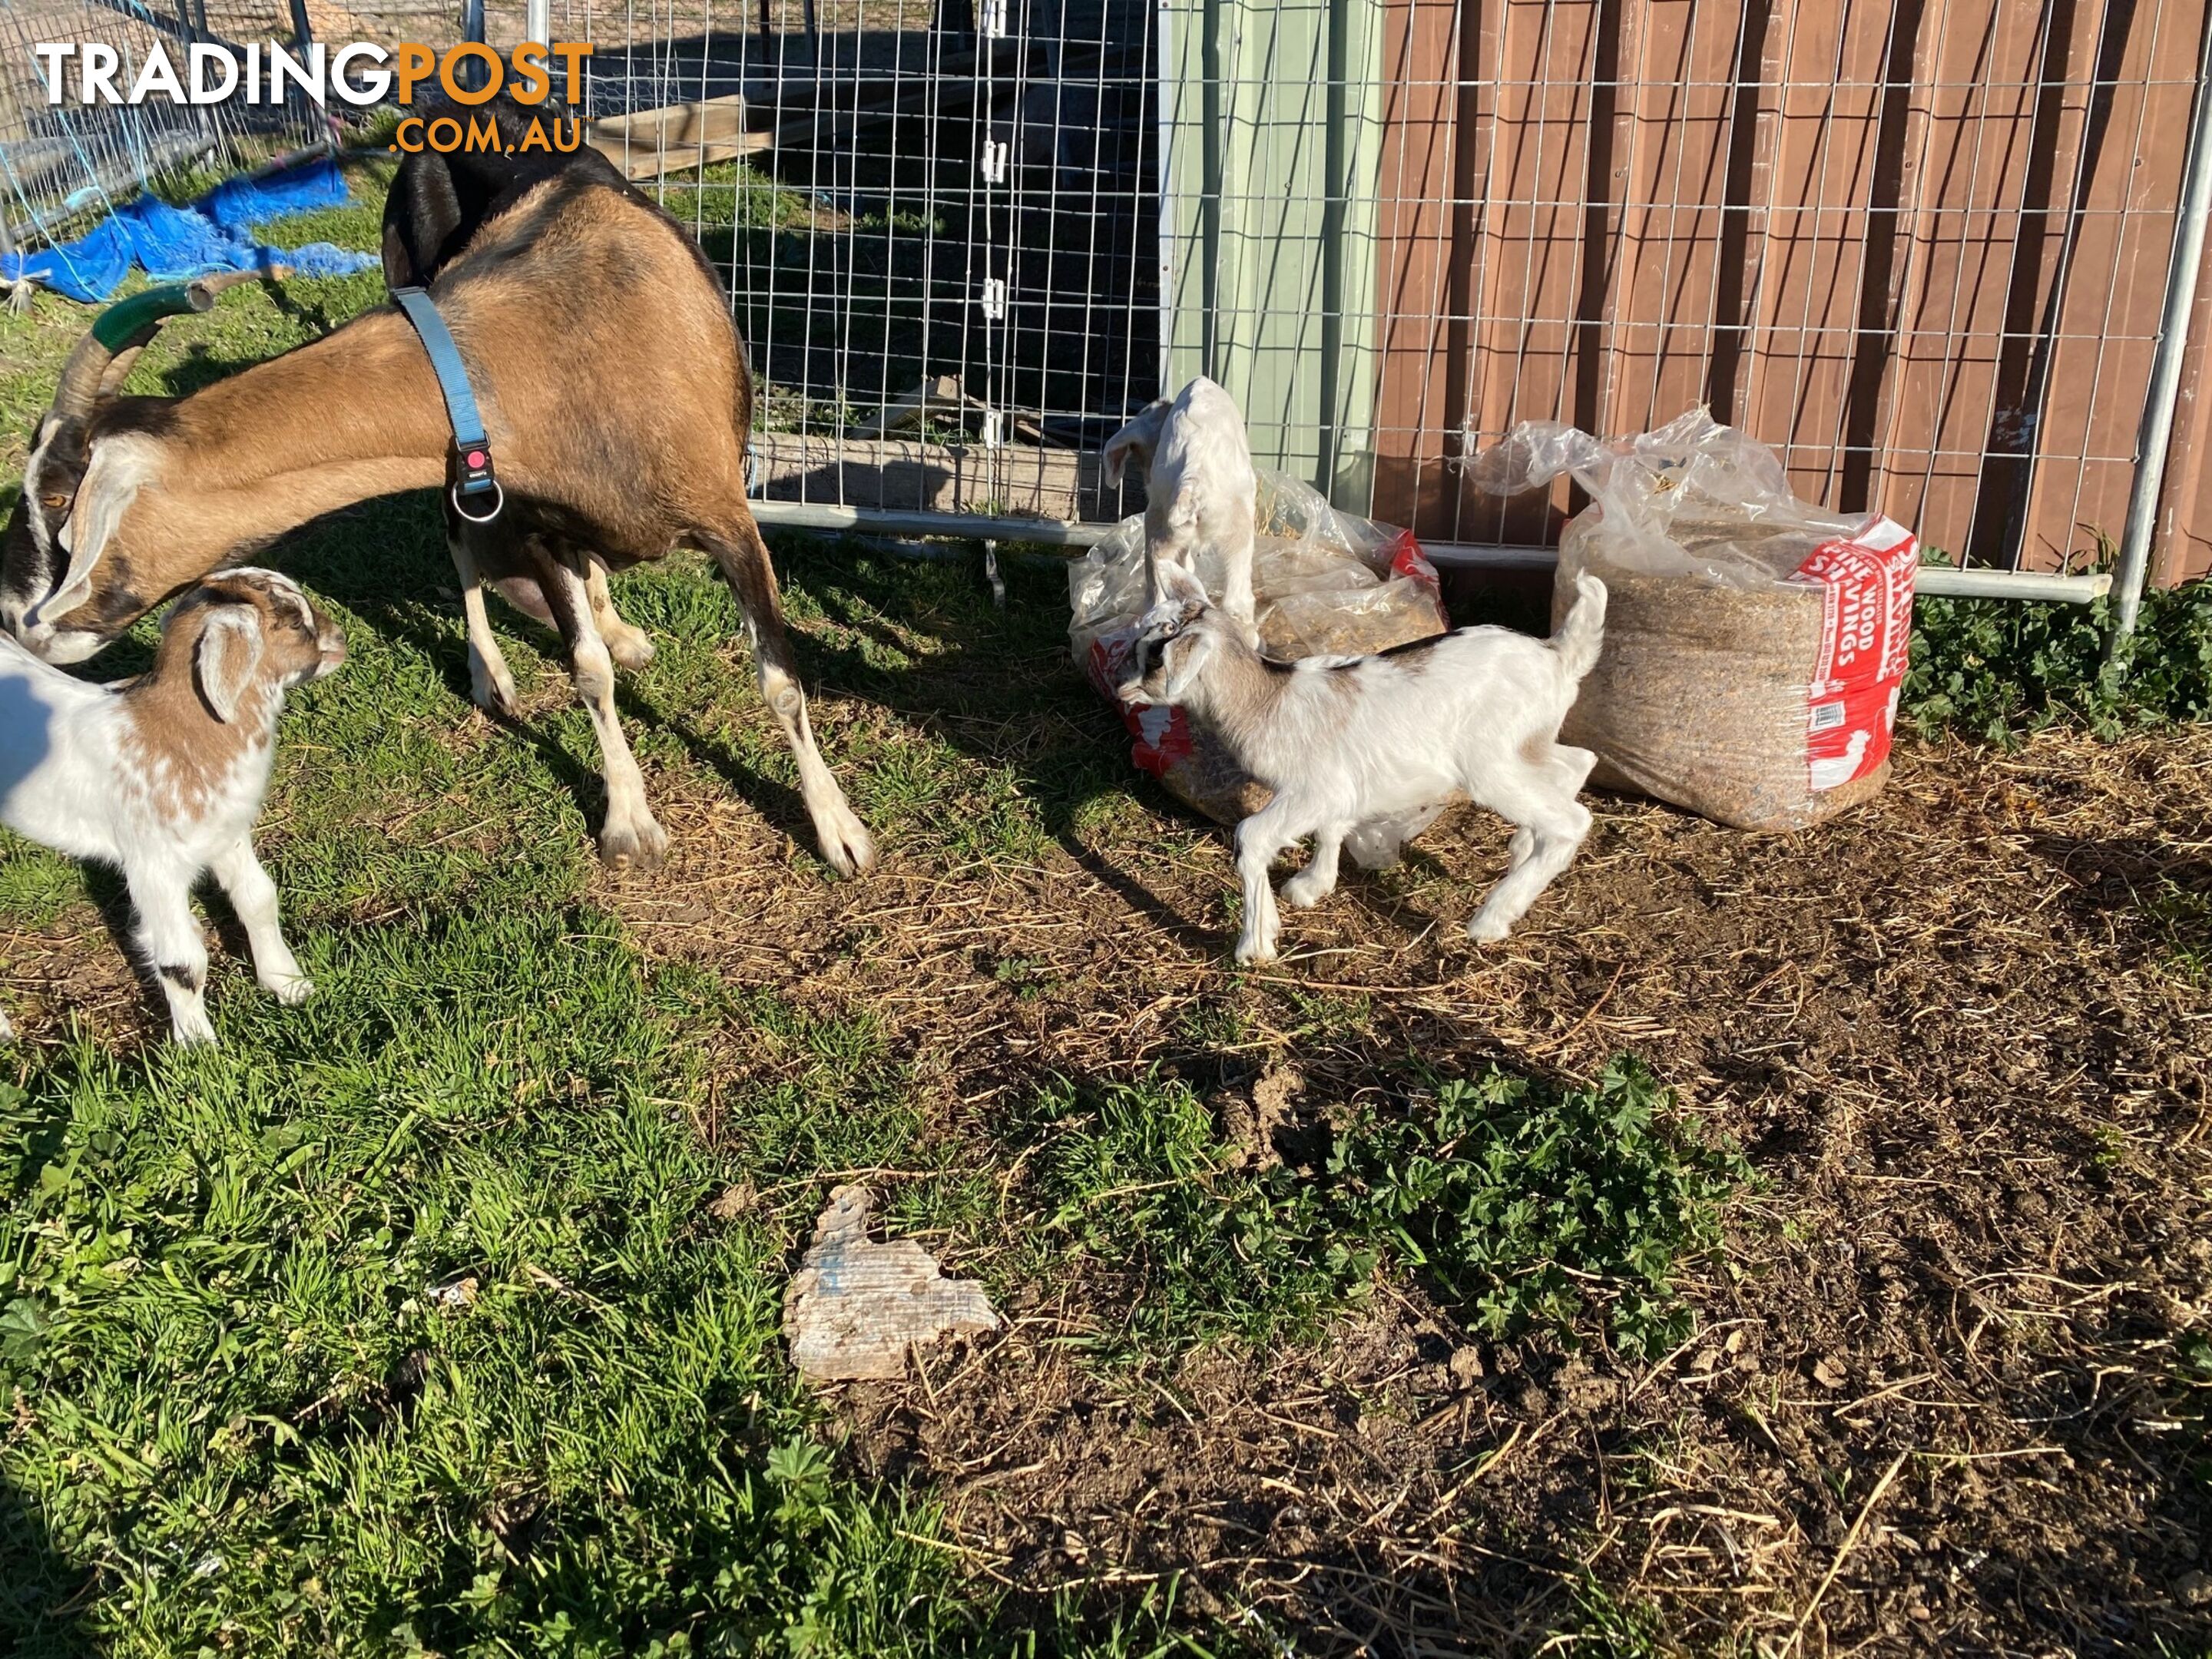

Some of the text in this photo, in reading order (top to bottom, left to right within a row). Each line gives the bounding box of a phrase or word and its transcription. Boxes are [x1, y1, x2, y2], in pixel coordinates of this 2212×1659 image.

[1808, 555, 1863, 667] SHAVINGS
[1822, 545, 1874, 581] PINE
[1859, 584, 1877, 651] WOOD
[1884, 555, 1902, 678] SHAVINGS
